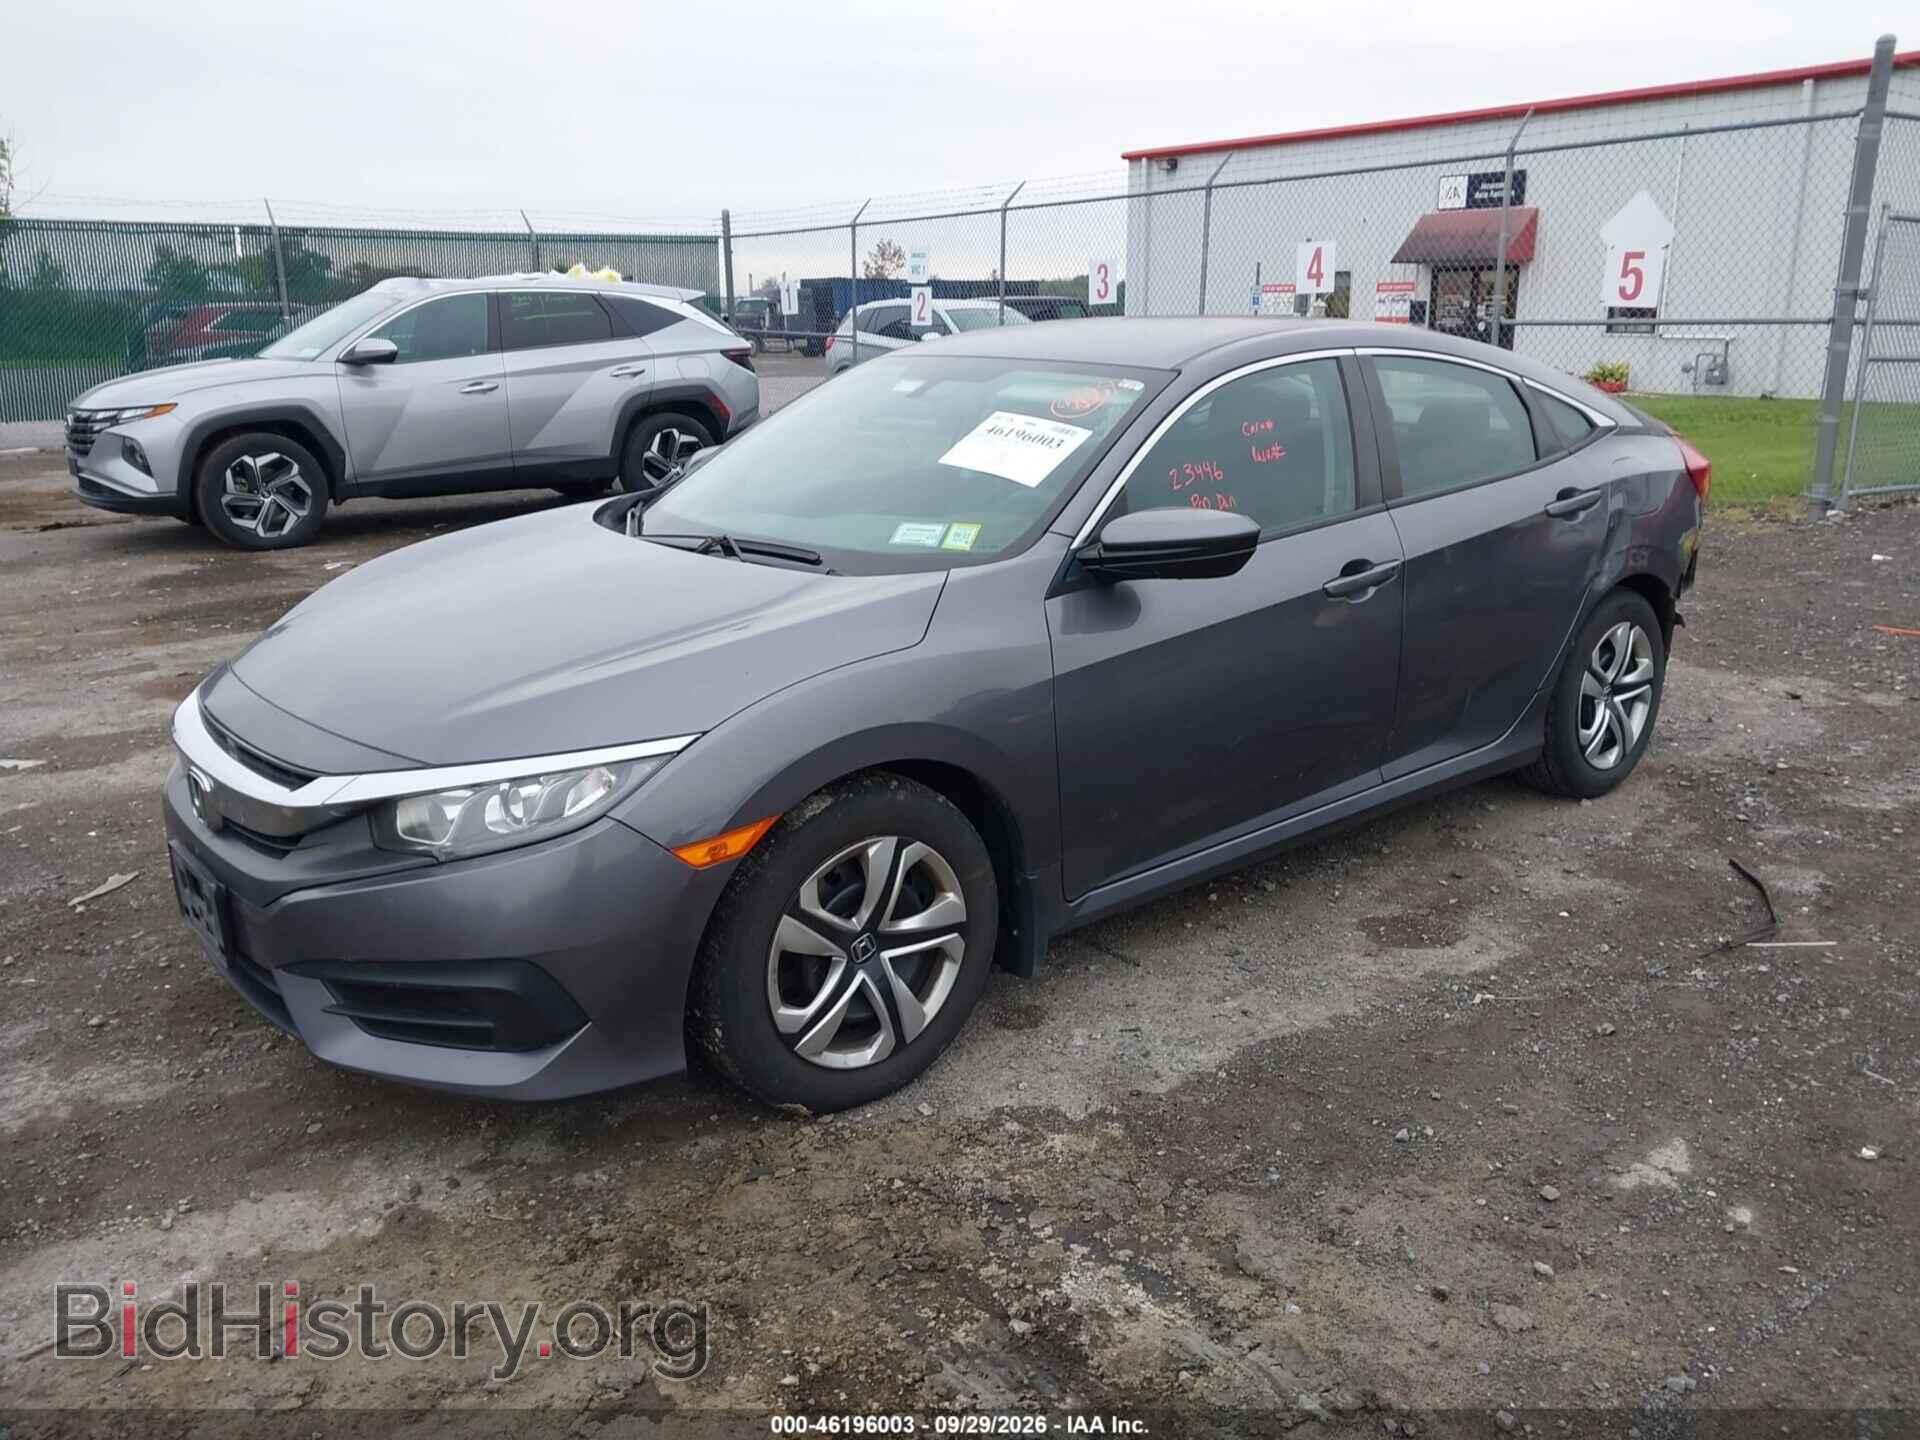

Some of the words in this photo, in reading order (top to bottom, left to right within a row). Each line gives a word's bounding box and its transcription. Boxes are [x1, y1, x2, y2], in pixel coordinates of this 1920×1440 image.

[1096, 263, 1109, 300] 3
[1307, 246, 1324, 288] 4
[1618, 251, 1645, 301] 5
[785, 283, 792, 310] 1
[916, 291, 926, 321] 2
